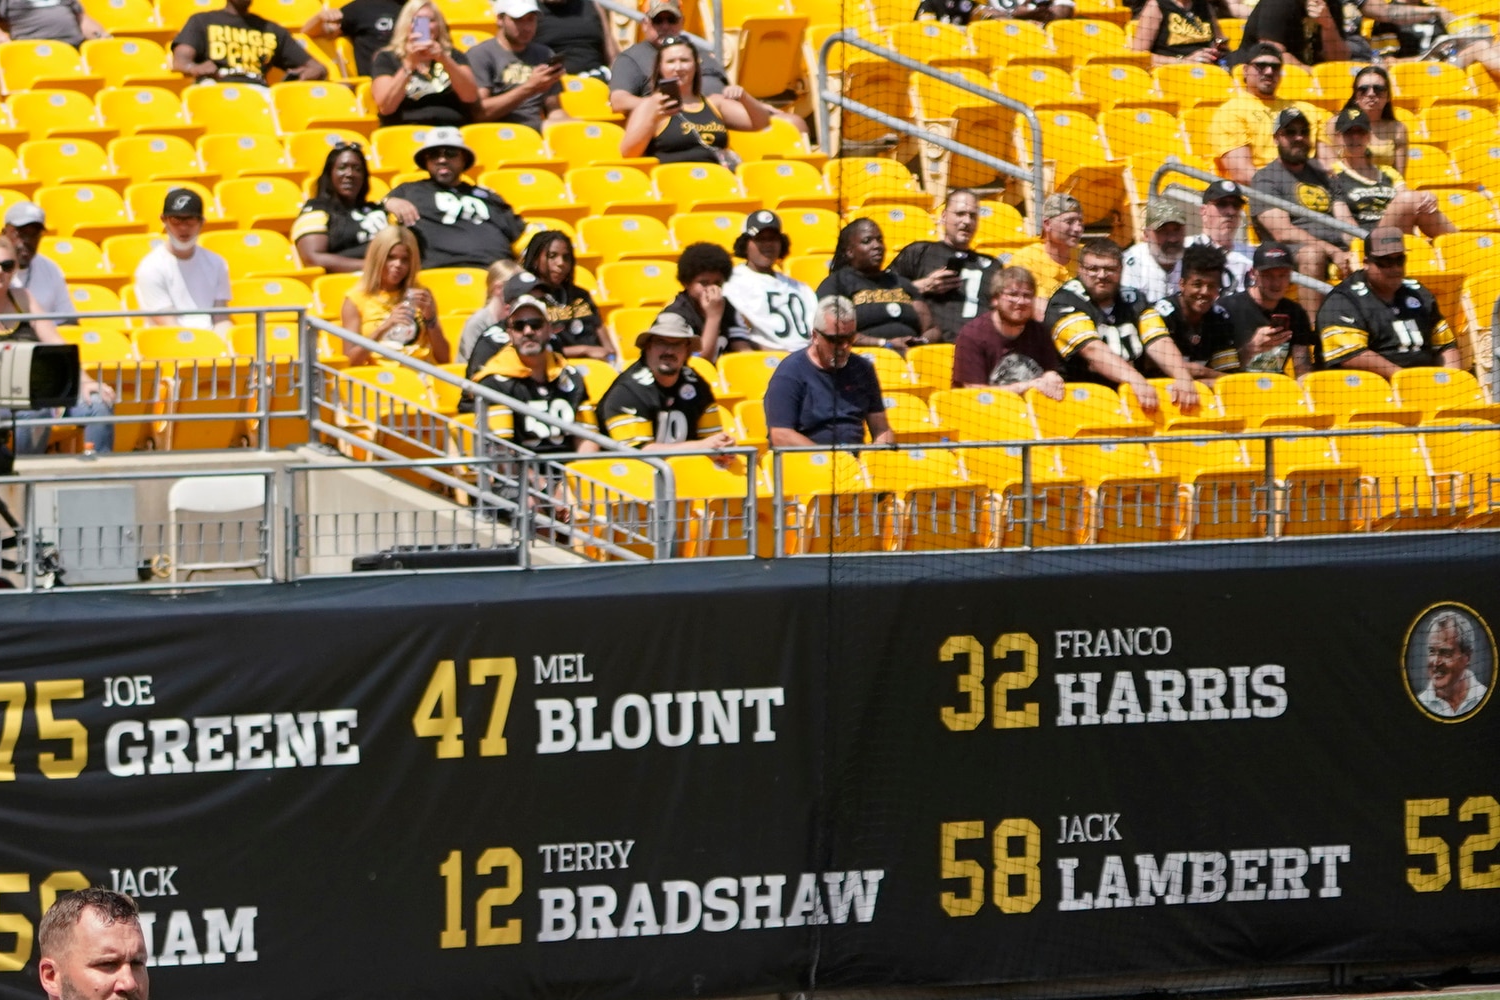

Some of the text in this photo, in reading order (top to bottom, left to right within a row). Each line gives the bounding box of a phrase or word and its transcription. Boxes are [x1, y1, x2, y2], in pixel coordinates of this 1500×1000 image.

[207, 25, 277, 50] RINGS
[767, 291, 810, 339] 50
[533, 653, 594, 685] MEL
[1055, 627, 1173, 659] FRANCO
[102, 675, 156, 708] JOE
[412, 657, 517, 759] 47
[938, 632, 1040, 731] 32
[1055, 664, 1289, 727] HARRIS
[104, 708, 361, 778] GREENE
[534, 687, 785, 754] BLOUNT
[538, 840, 635, 873] TERRY
[1057, 813, 1123, 844] JACK
[1404, 795, 1500, 893] 52
[109, 866, 179, 898] JACK
[440, 847, 524, 949] 12
[938, 817, 1042, 918] 58
[1056, 845, 1352, 912] LAMBERT
[537, 869, 885, 942] BRADSHAW
